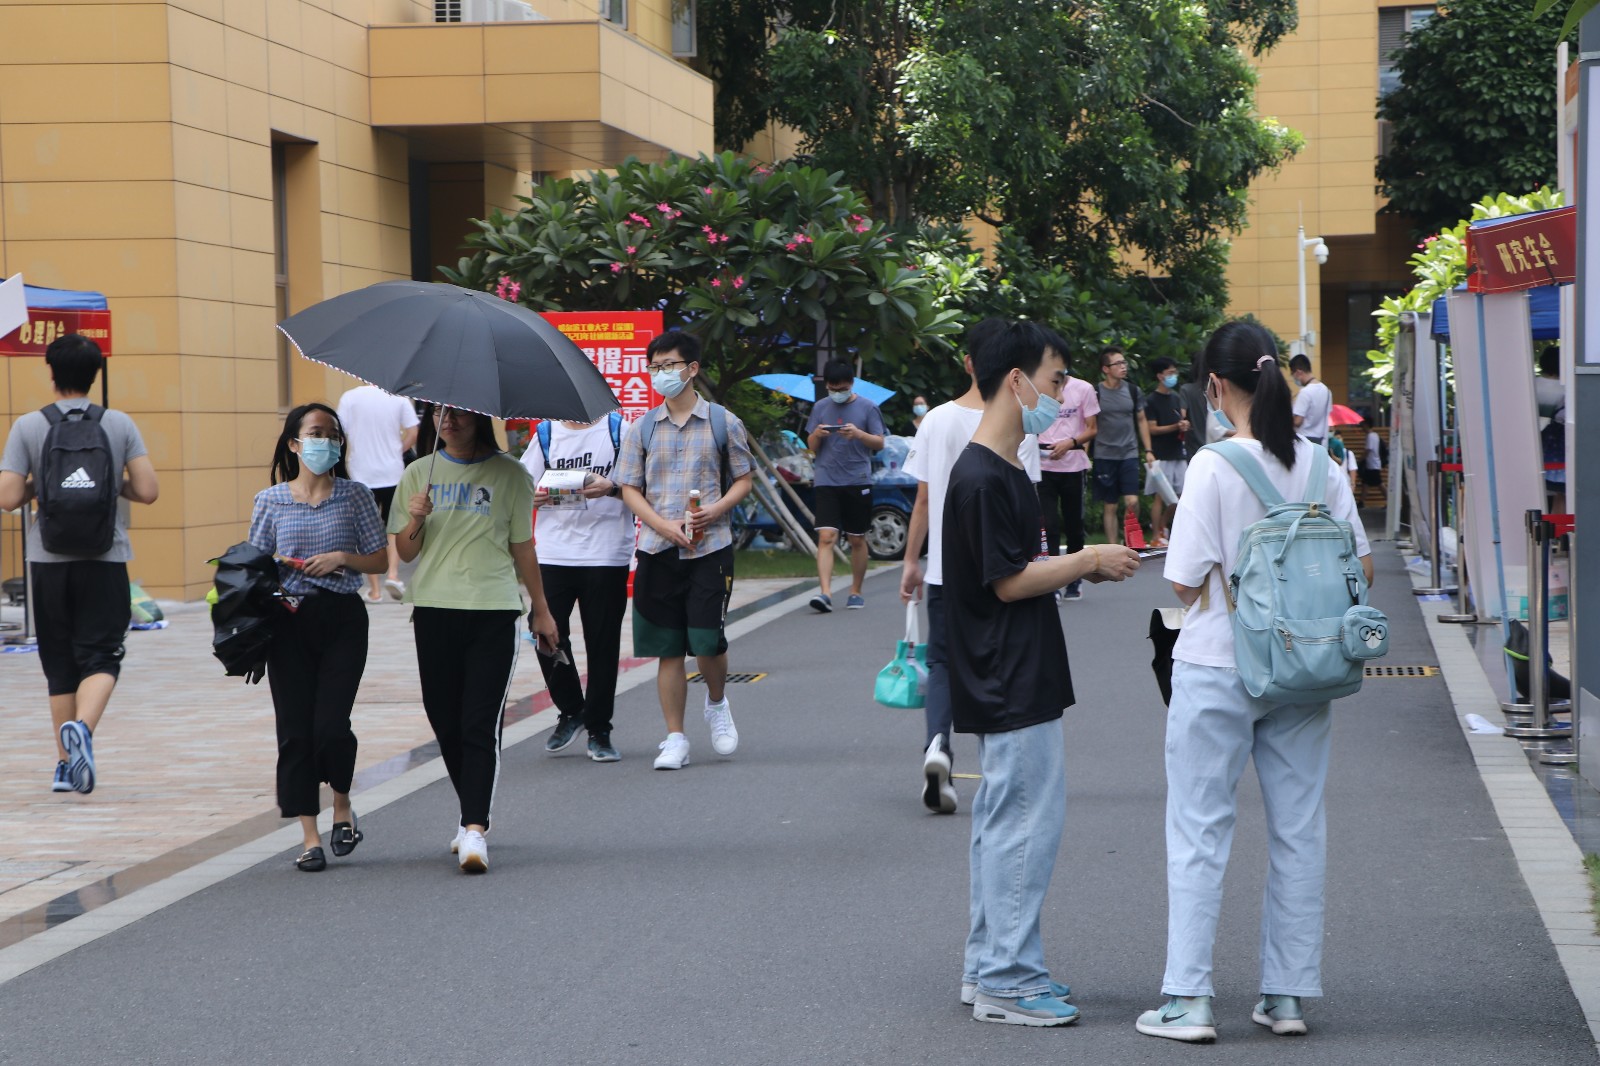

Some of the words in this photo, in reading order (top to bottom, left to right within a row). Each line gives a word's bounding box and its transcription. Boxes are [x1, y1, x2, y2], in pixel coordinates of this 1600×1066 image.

[1495, 232, 1558, 275] 研究生会
[431, 482, 471, 506] THIN
